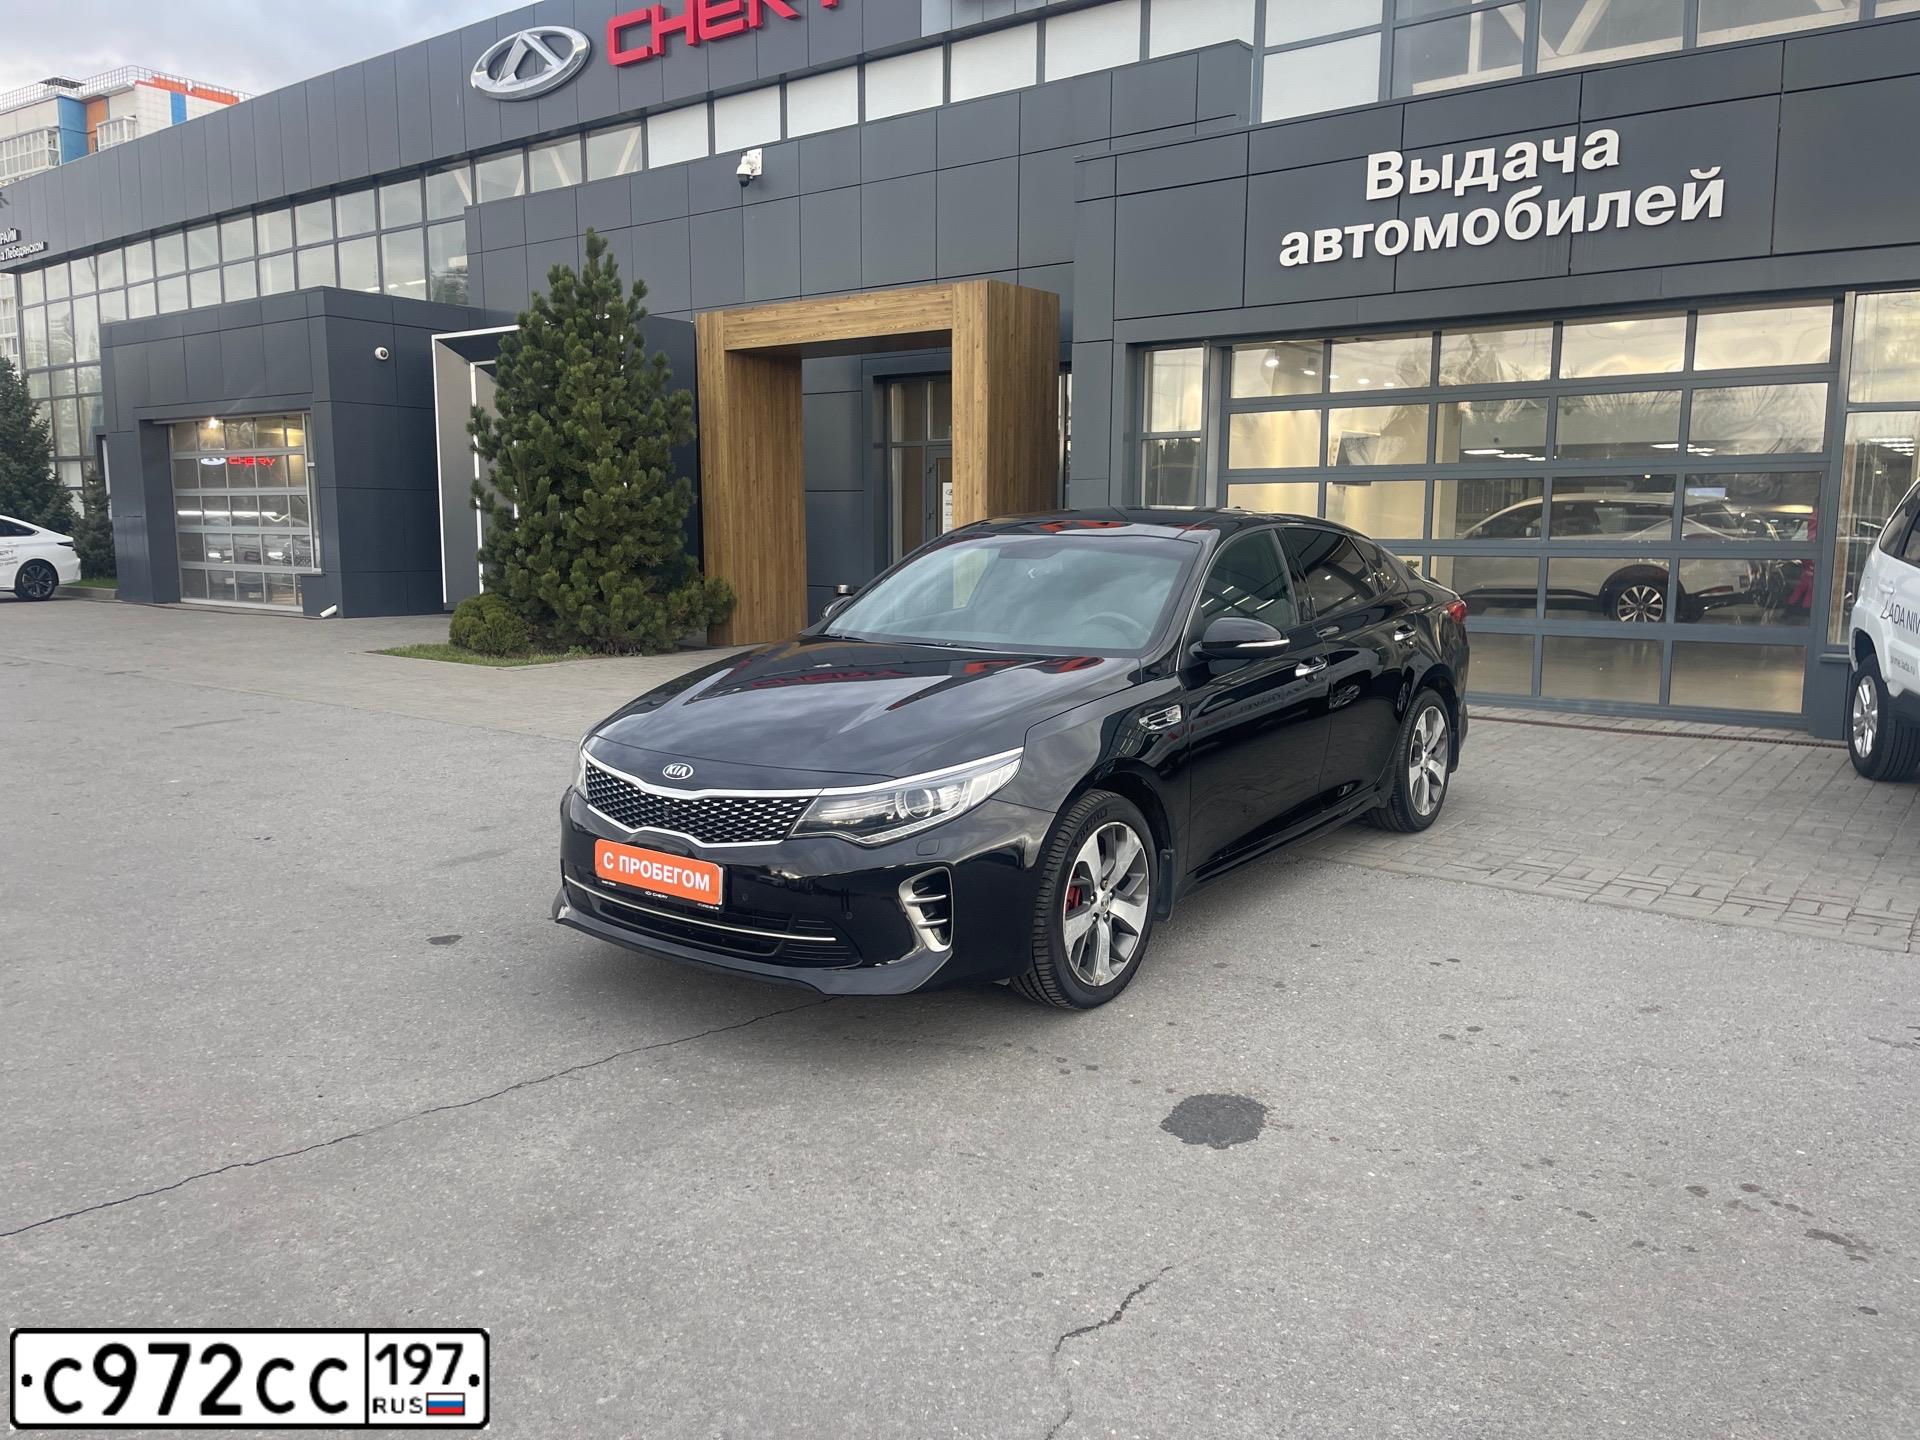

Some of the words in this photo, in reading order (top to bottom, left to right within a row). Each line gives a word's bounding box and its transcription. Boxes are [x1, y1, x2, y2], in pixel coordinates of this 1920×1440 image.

[607, 0, 838, 66] CHE
[1366, 128, 1620, 200] Выдача
[1279, 166, 1725, 267] автомобилей
[227, 455, 276, 466] CHERY
[1880, 599, 1905, 628] LADA
[665, 765, 688, 777] KIA
[618, 855, 710, 892] ПРОБЕГОМ
